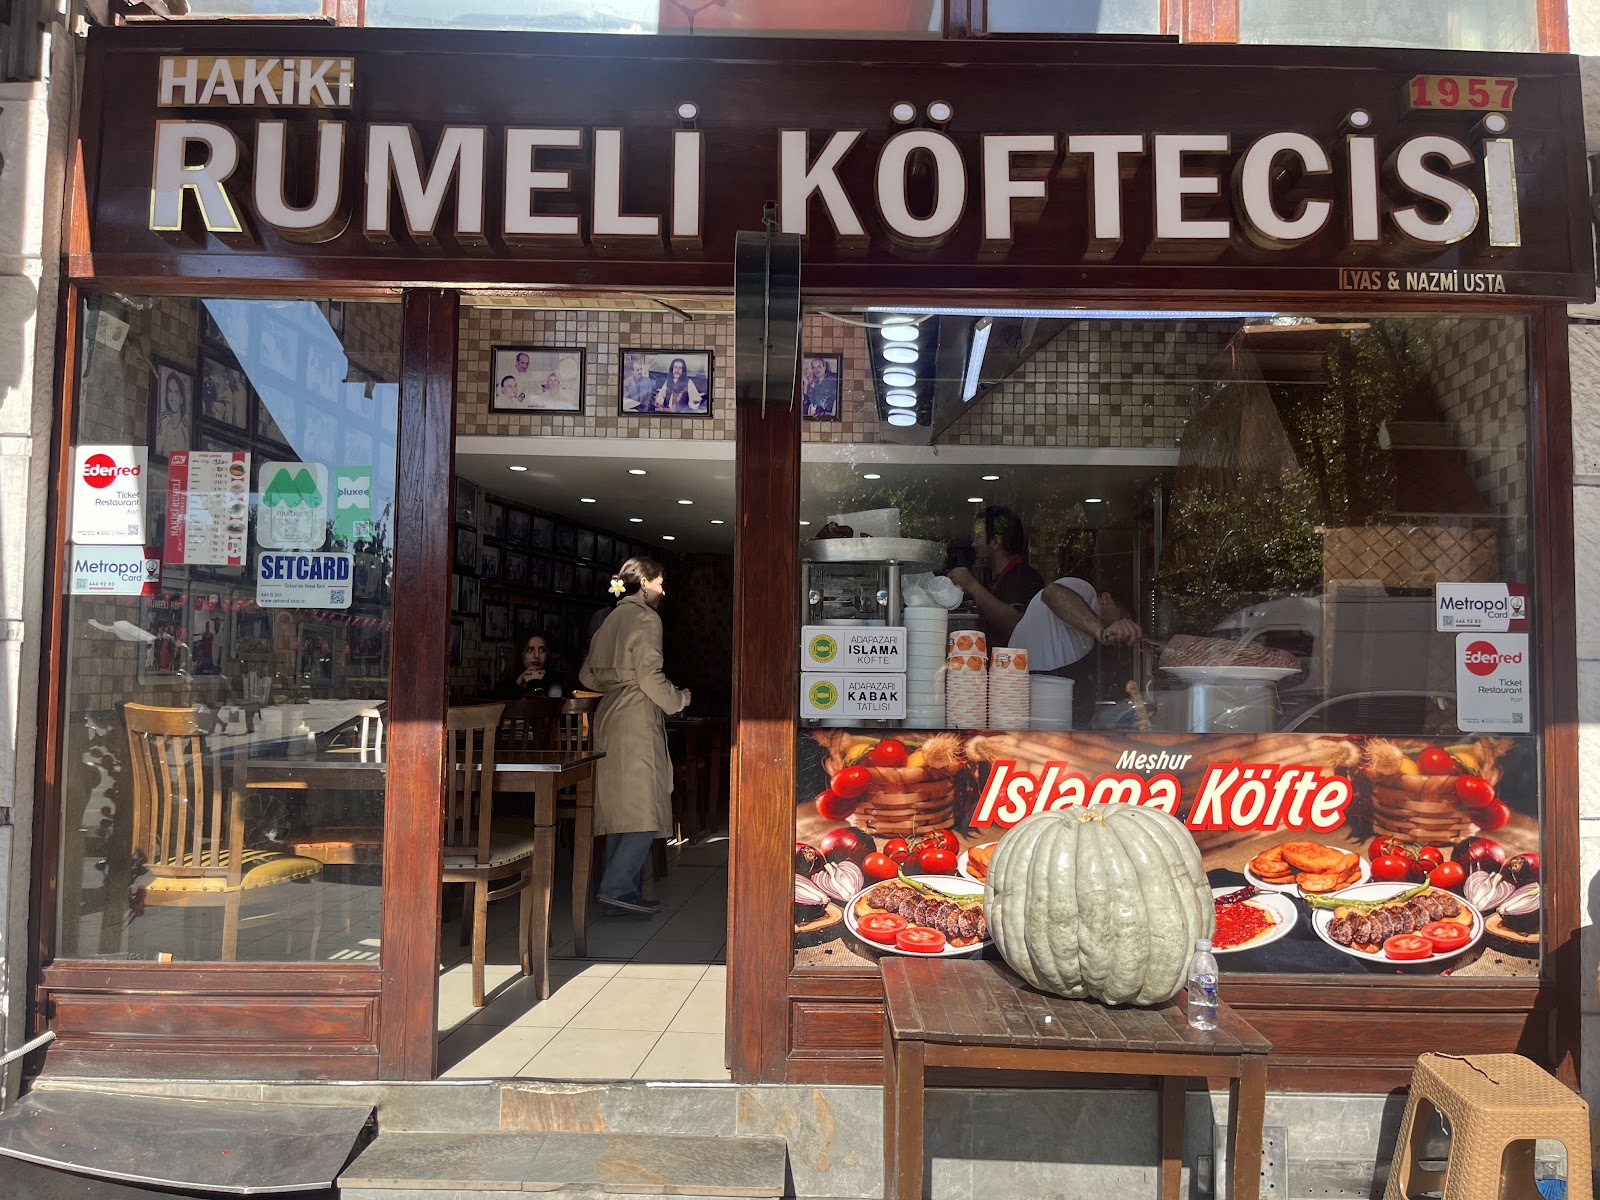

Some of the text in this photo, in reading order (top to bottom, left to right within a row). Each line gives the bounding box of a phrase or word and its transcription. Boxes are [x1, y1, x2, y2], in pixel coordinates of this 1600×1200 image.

[1411, 76, 1517, 109] 1957
[150, 101, 1521, 247] RUMELİ KÖFTECİSİ
[1338, 268, 1506, 293] İLYAS & NAZMİ USTA
[82, 464, 141, 477] Edenred
[117, 491, 140, 499] Ticket
[338, 488, 370, 497] pluxee
[95, 499, 140, 507] Restaurant
[74, 560, 142, 576] Metropol
[261, 555, 349, 580] SETCARD
[121, 573, 142, 582] Card
[1440, 597, 1508, 613] Metropol
[1488, 611, 1508, 619] Card
[850, 635, 897, 644] ADAPAZARI
[848, 645, 899, 655] ISLAMA
[857, 654, 890, 665] KÖFTE
[1464, 651, 1522, 664] Edenred
[848, 682, 896, 691] ADAPAZARI
[1499, 679, 1522, 687] Ticket
[1478, 686, 1522, 694] Restaurant
[847, 691, 899, 702] KABAK
[857, 702, 890, 711] TATLISI
[1116, 750, 1192, 774] Meşhur
[977, 763, 1346, 828] Islama Köfte
